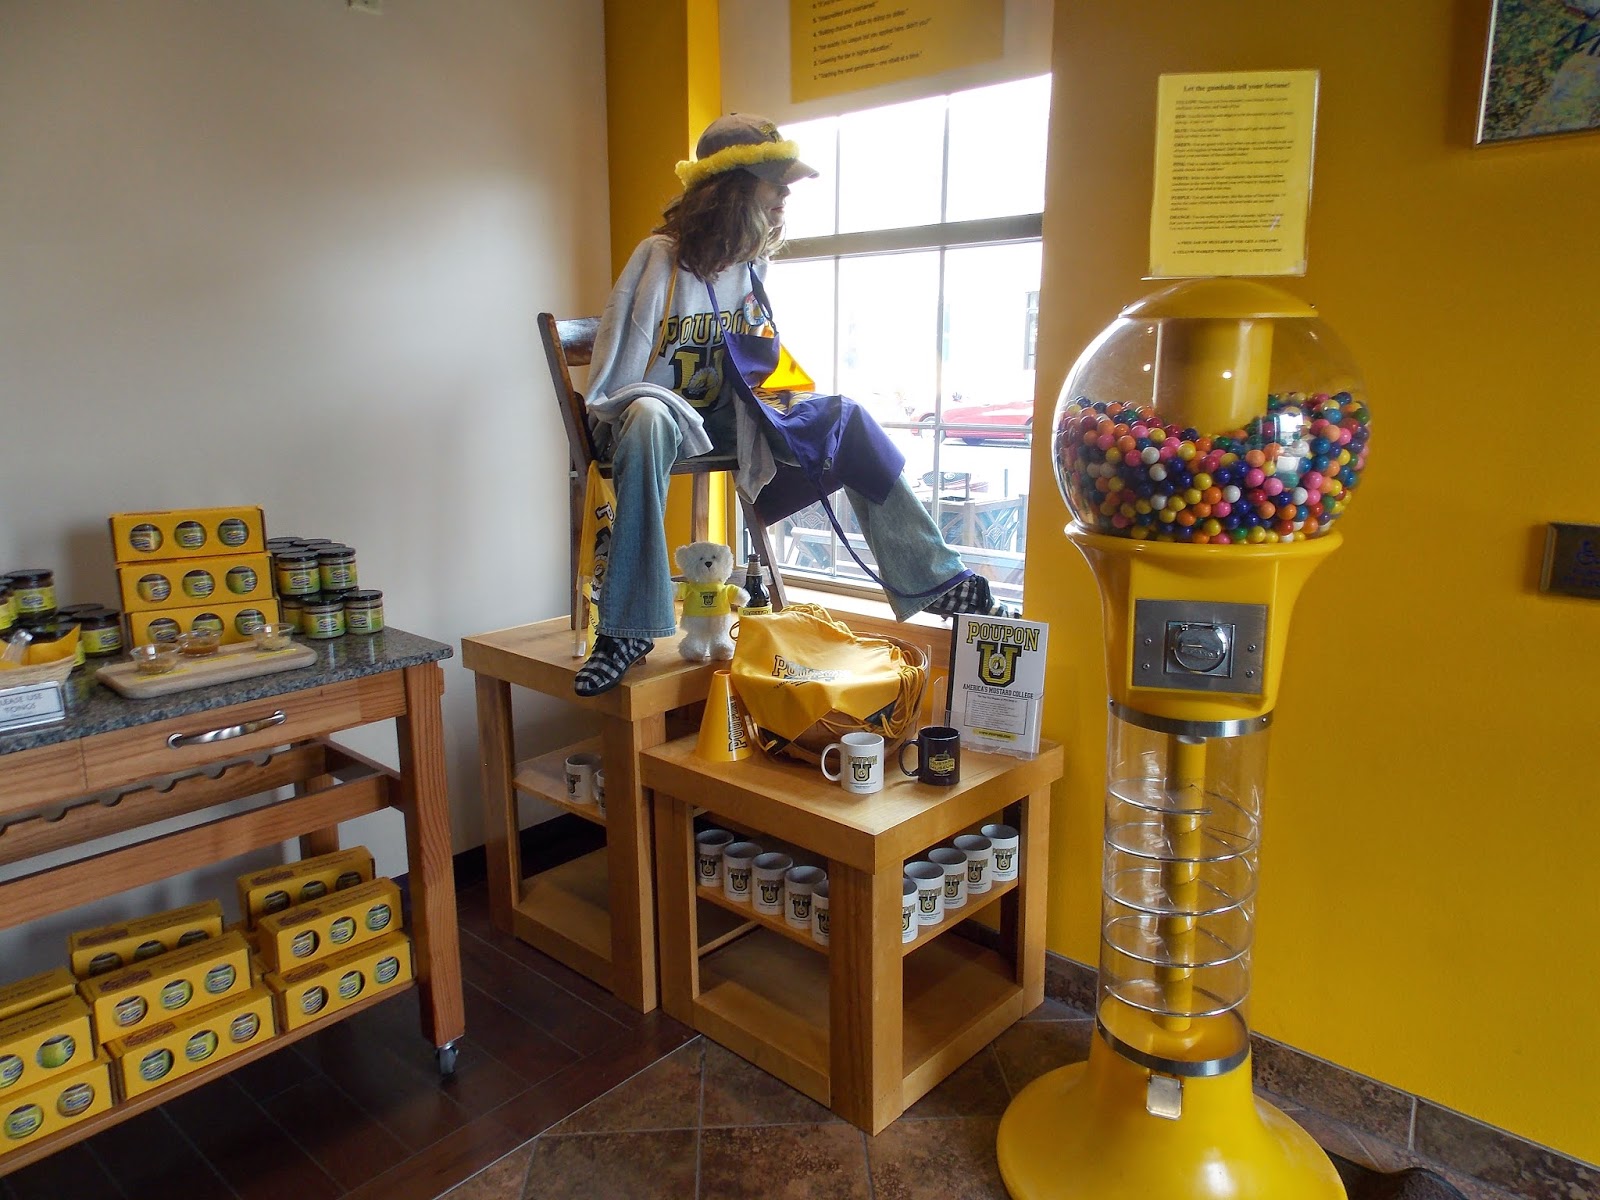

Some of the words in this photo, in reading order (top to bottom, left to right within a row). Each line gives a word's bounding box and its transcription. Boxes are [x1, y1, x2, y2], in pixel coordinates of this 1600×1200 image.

[1206, 84, 1236, 93] gumballs
[659, 308, 748, 357] POUPO
[966, 621, 1040, 651] POUPON
[976, 640, 1022, 688] U
[962, 683, 988, 693] AMERICA'S
[988, 687, 1012, 697] MUSTARD
[1012, 690, 1034, 699] COLLEGE
[847, 755, 878, 766] POUPON
